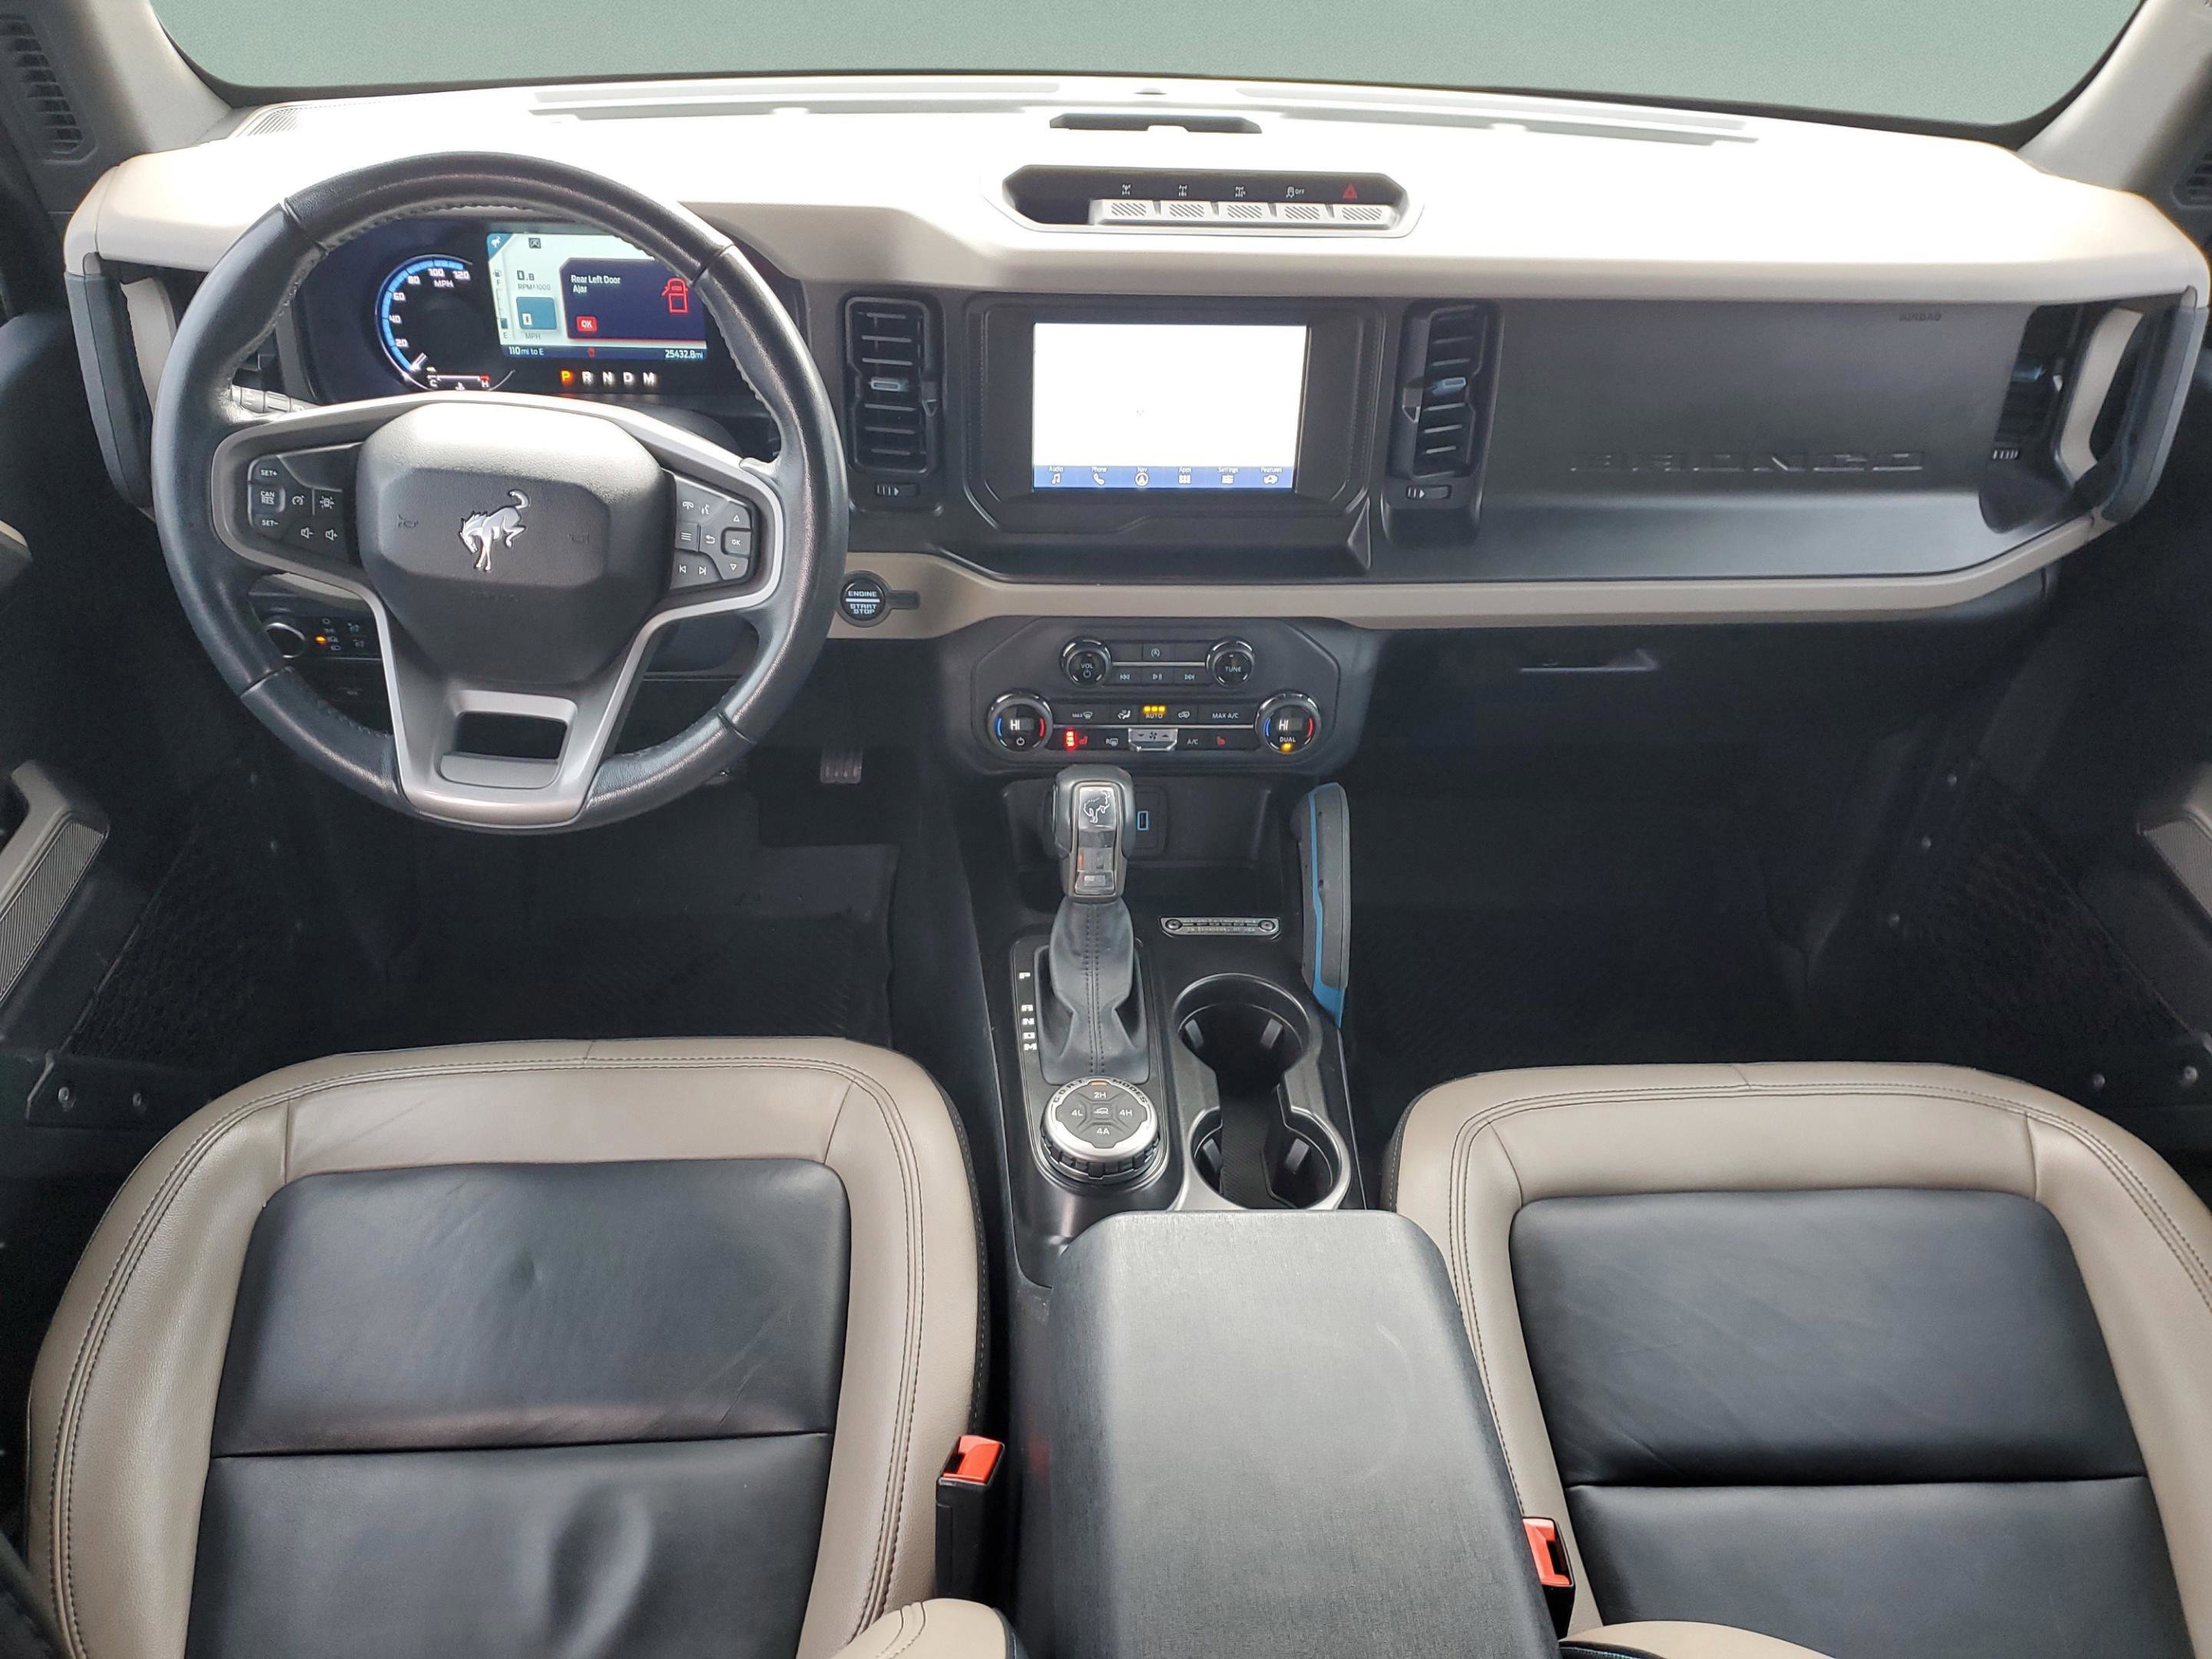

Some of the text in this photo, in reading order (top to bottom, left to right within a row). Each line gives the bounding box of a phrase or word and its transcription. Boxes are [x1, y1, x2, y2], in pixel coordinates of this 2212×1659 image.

[428, 268, 445, 277] 100
[452, 270, 471, 280] 120
[407, 276, 421, 285] 80
[434, 280, 454, 288] MPH
[571, 275, 621, 284] Rear Left Door
[572, 285, 588, 293] Ajar
[392, 292, 406, 301] 60
[389, 315, 402, 323] 40
[581, 320, 593, 329] OK
[395, 339, 409, 348] 20
[561, 370, 656, 384] P R N D M
[1010, 719, 1021, 731] HI
[1278, 720, 1289, 731] HI
[1113, 1078, 1148, 1104] MODES
[1096, 1127, 1110, 1135] 4A
